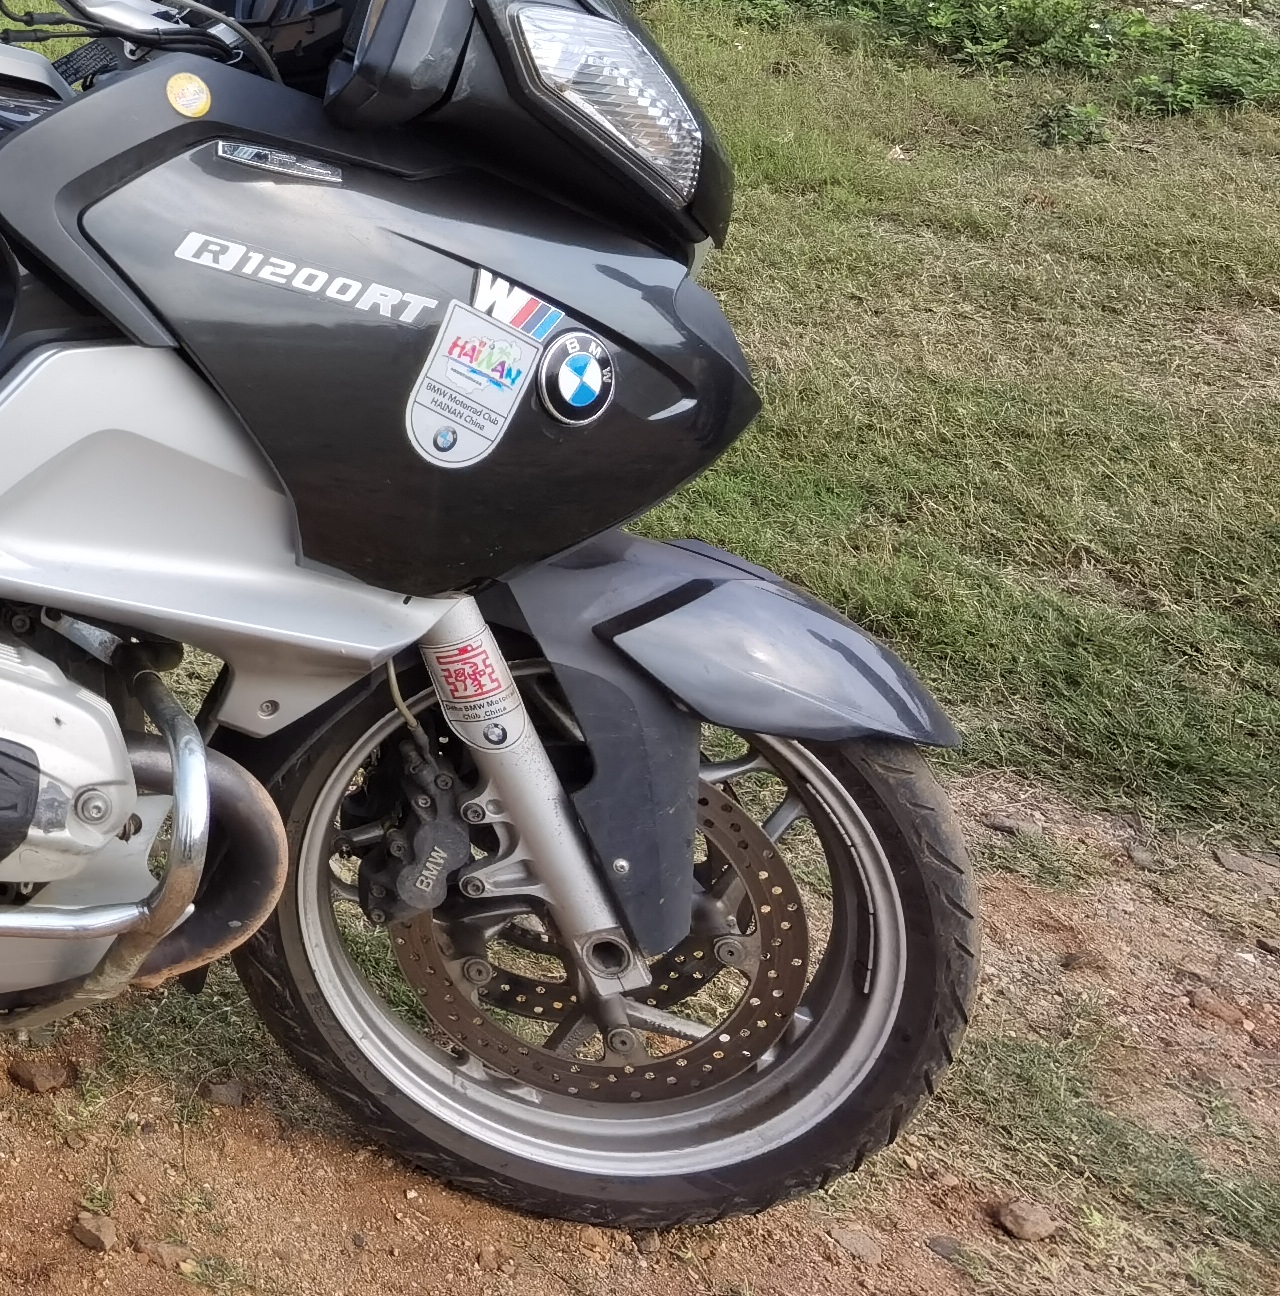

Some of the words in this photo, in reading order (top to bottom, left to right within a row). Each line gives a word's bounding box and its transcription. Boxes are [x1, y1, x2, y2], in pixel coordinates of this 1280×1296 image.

[176, 232, 439, 323] R1200RT
[565, 337, 612, 384] BMW
[426, 382, 448, 400] BMW
[447, 393, 482, 417] Motorrad
[483, 412, 499, 426] Club
[430, 397, 464, 420] HAINAN
[464, 415, 485, 431] China
[416, 845, 448, 892] BMW
